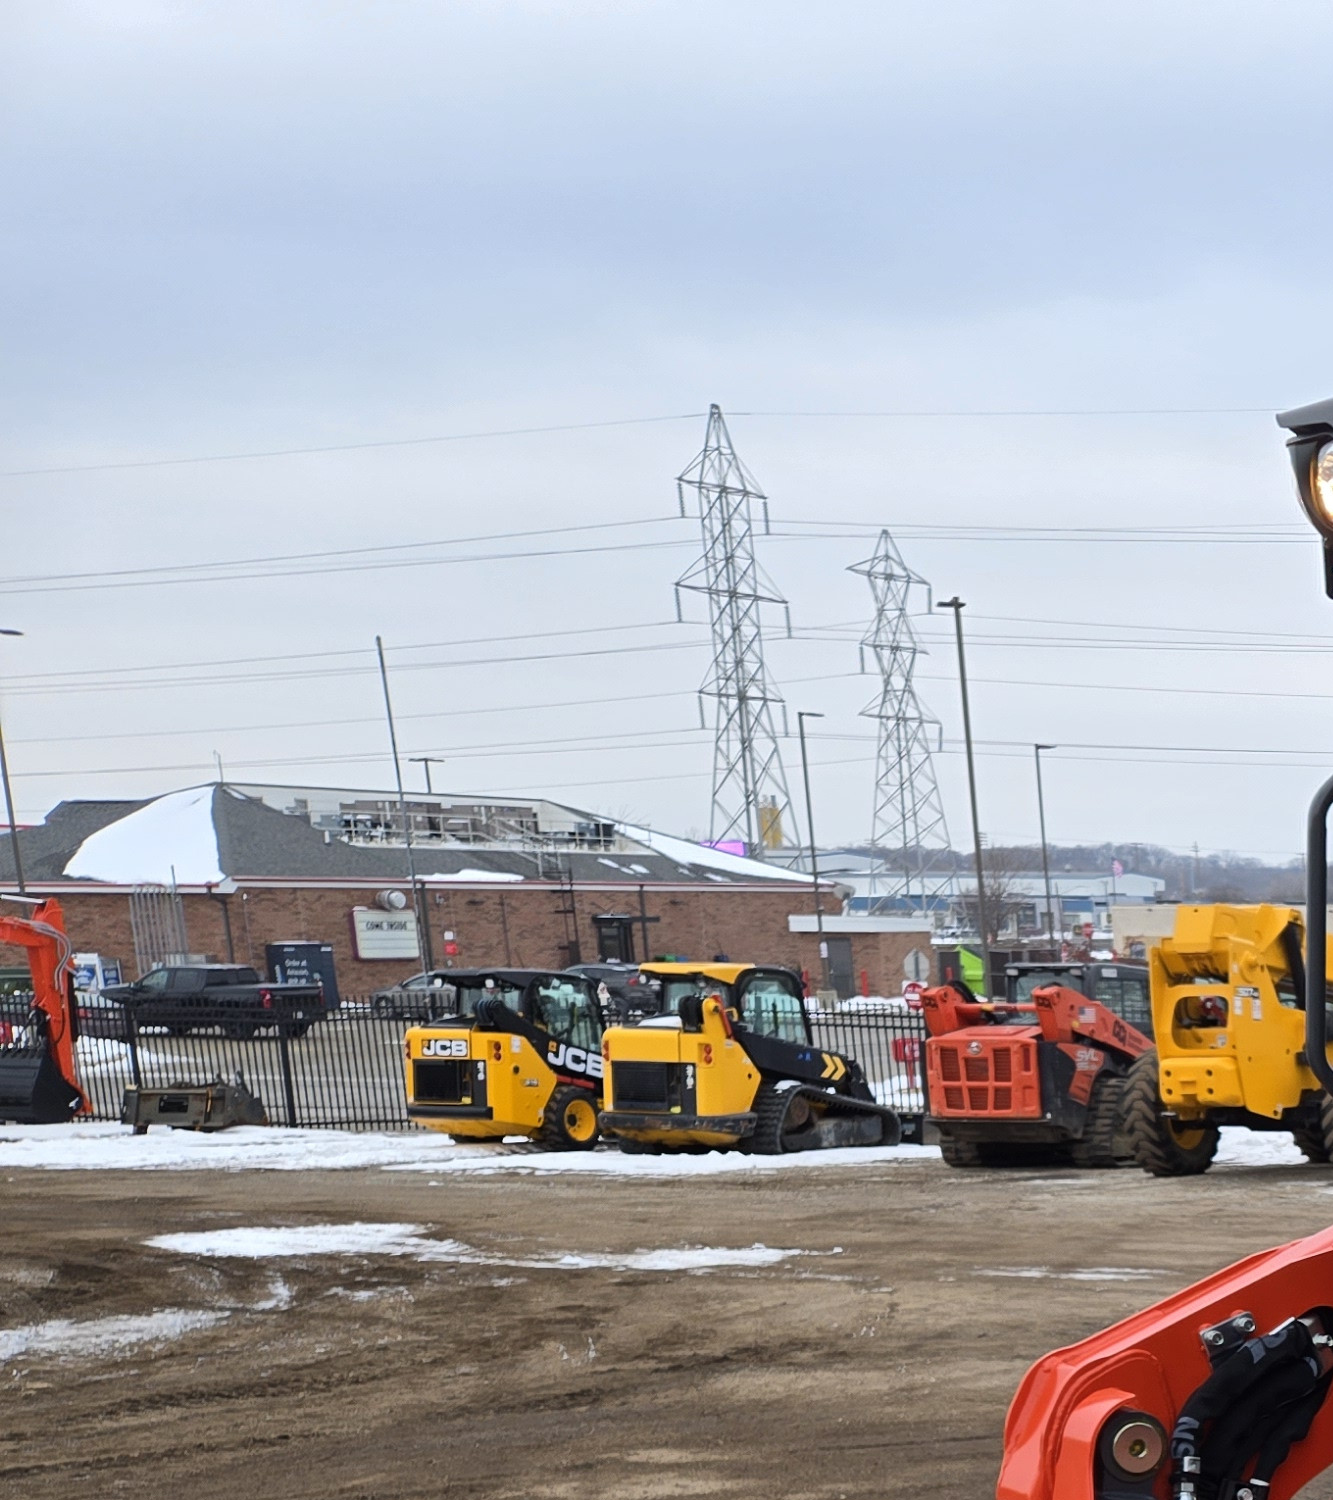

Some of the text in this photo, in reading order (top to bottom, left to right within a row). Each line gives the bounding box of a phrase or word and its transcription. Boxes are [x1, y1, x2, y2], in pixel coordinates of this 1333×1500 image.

[365, 921, 384, 932] COME
[422, 1039, 468, 1057] JCB
[547, 1042, 604, 1079] JCB
